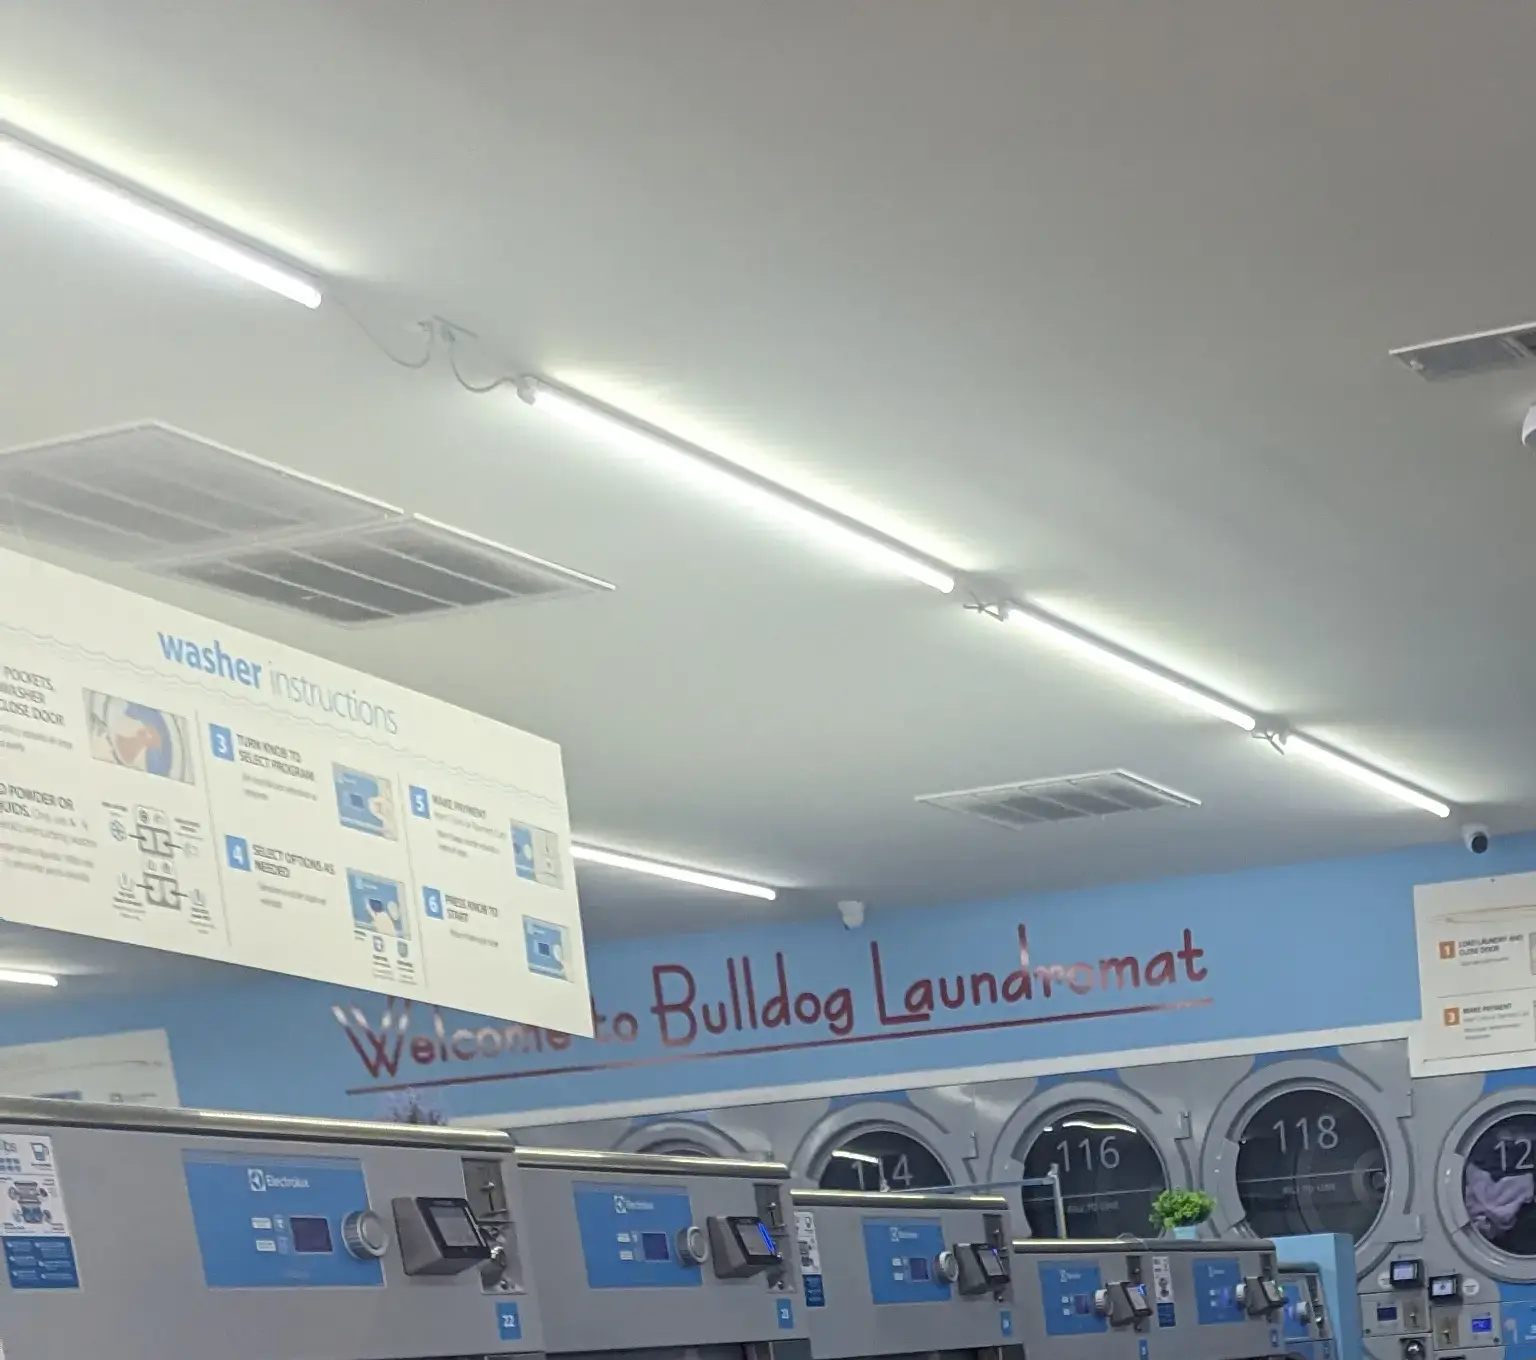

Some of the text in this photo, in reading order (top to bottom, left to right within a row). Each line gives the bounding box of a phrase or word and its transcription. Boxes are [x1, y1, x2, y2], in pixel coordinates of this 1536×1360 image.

[157, 631, 398, 735] washer instructions
[216, 733, 227, 753] 3
[415, 794, 425, 812] 5
[232, 844, 244, 865] 4
[428, 895, 440, 913] 6
[331, 995, 574, 1079] Welcome
[650, 951, 854, 1048] Bulldog
[870, 923, 1209, 1027] Laundromat
[1273, 1114, 1340, 1153] 118
[1056, 1135, 1121, 1172] 116
